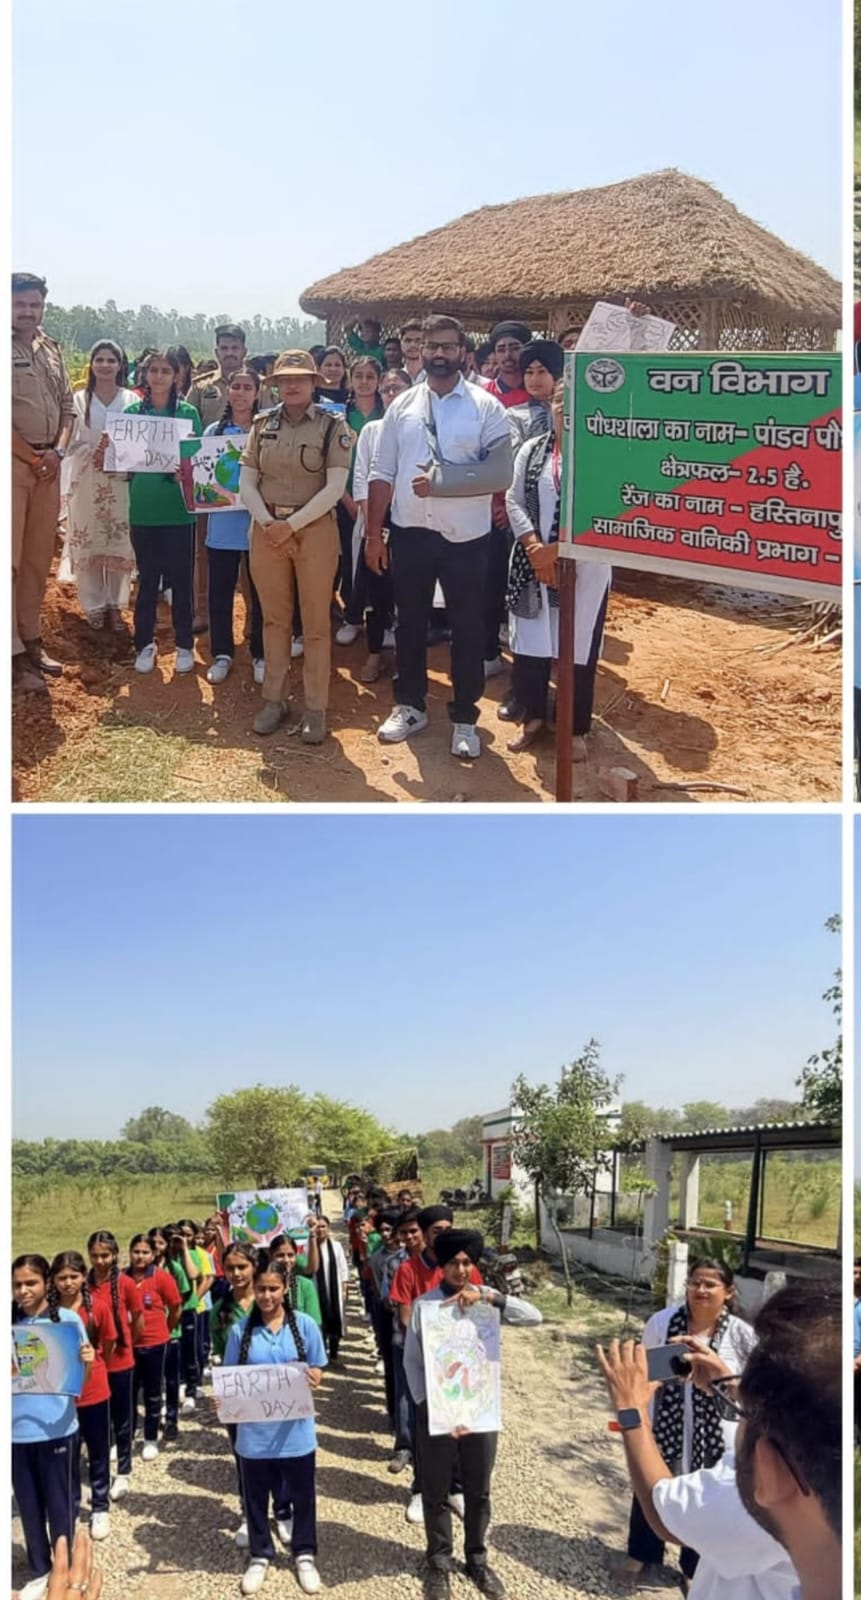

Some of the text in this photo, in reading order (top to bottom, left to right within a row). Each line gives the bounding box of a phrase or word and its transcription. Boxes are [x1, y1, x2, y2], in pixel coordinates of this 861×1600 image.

[649, 361, 830, 397] वन विभाग
[113, 418, 175, 443] EARTH
[664, 420, 690, 440] का
[754, 417, 808, 448] पांडव
[815, 418, 842, 449] पौ
[144, 449, 175, 470] DAY
[747, 467, 777, 486] 2.5
[621, 485, 650, 507] रेंज
[654, 492, 680, 511] का
[684, 497, 725, 516] नाम
[593, 516, 675, 543] सामाजिक
[680, 526, 750, 554] वानिकी
[756, 539, 819, 564] प्रभाग
[222, 1368, 292, 1399] EARTH
[261, 1400, 295, 1418] DAY
